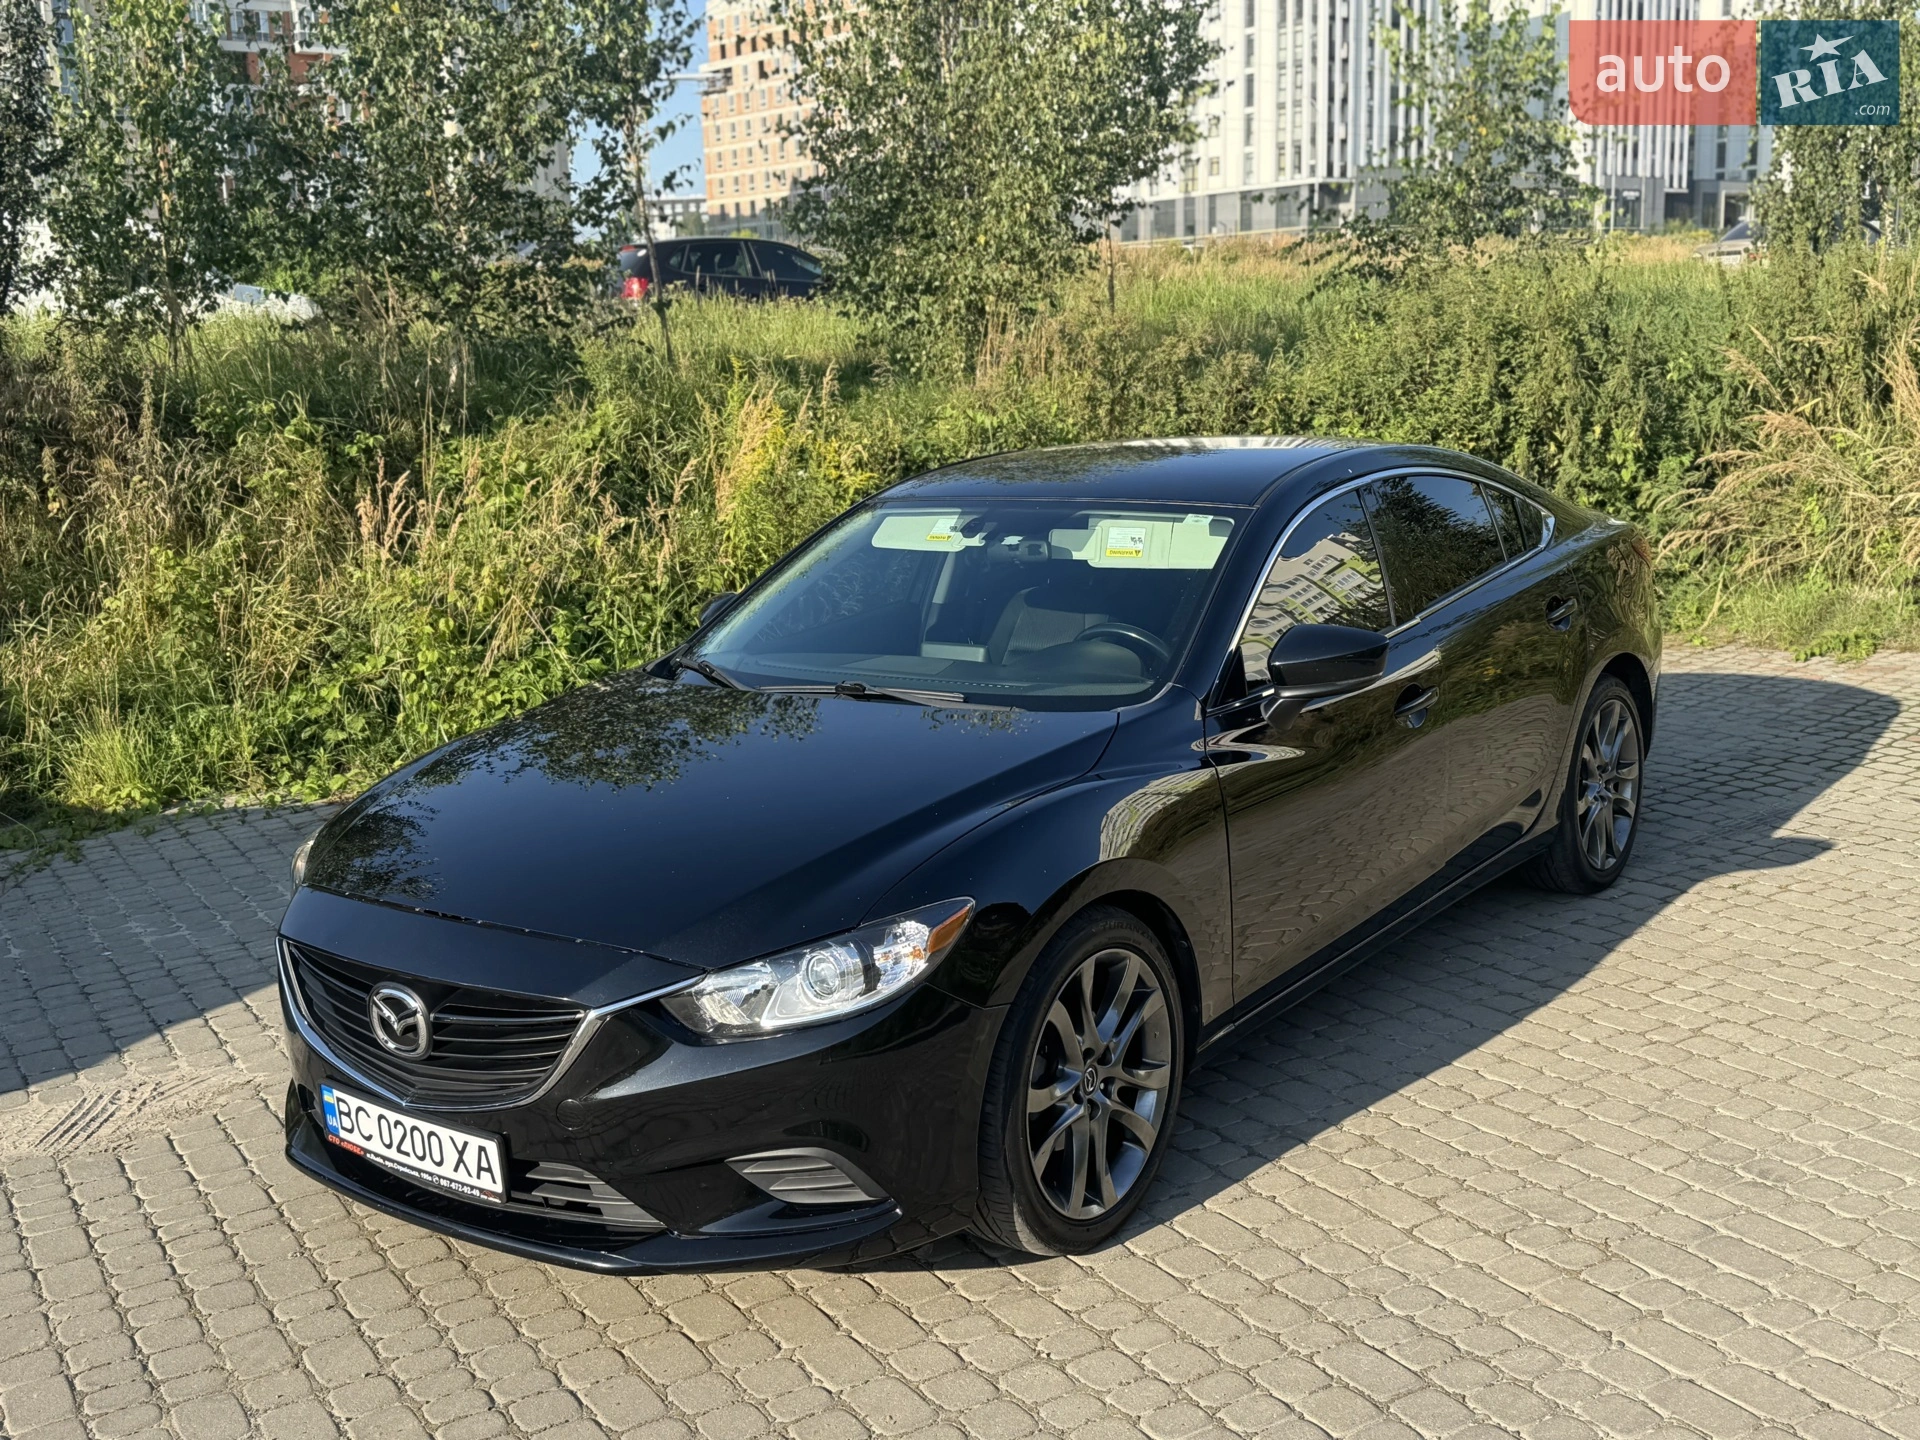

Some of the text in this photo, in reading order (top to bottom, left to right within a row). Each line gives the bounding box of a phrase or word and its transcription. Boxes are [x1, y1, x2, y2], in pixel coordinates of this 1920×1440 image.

[326, 1113, 338, 1128] UA
[335, 1097, 498, 1185] BC 0200 XA
